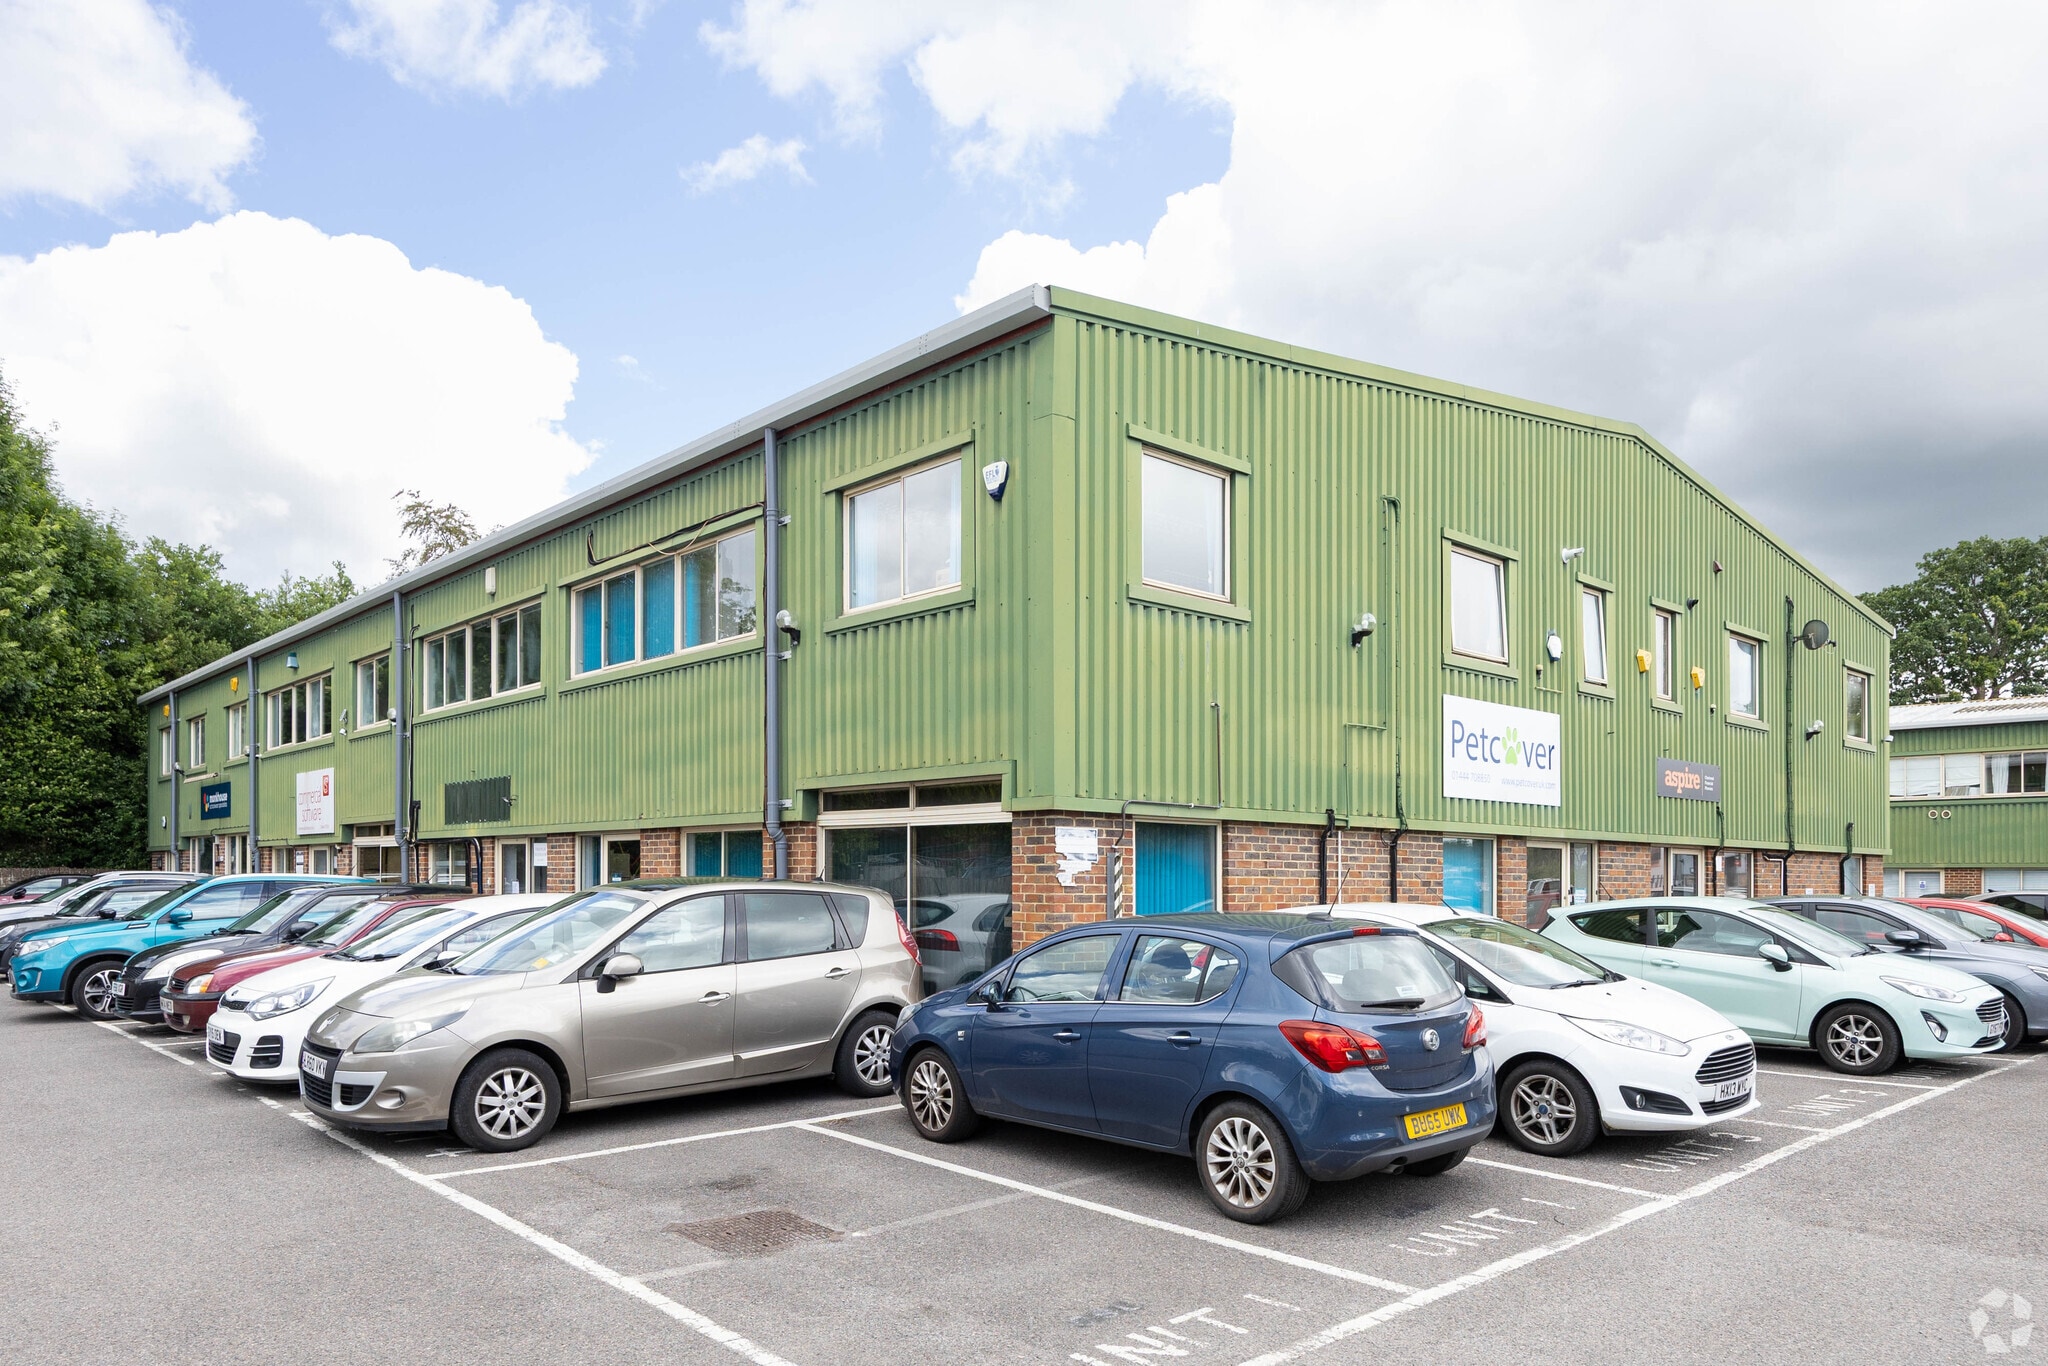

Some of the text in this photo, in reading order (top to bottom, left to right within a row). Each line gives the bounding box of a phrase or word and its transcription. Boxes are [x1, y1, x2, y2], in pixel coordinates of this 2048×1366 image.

[1664, 766, 1701, 794] aspire
[1719, 1081, 1737, 1099] HX13
[1410, 1105, 1464, 1135] BU65 UWK
[1388, 1207, 1538, 1257] UNIT
